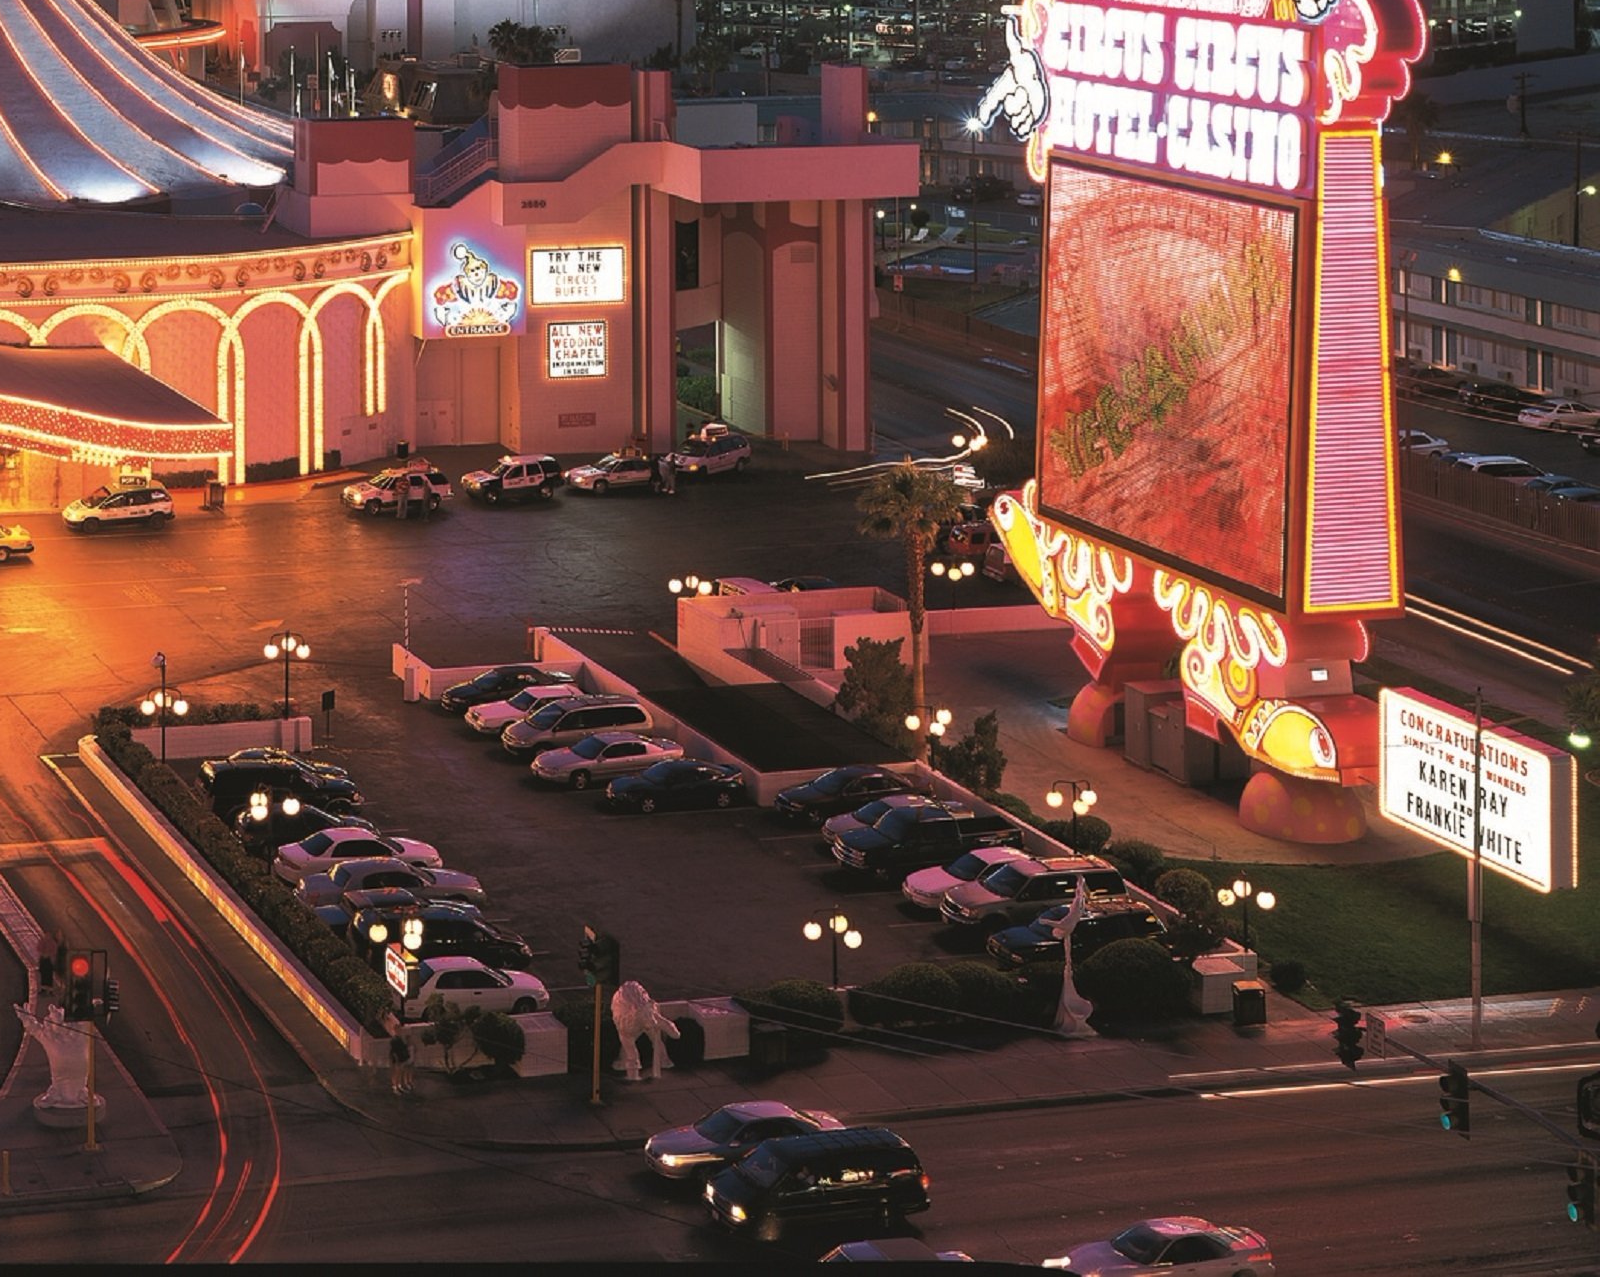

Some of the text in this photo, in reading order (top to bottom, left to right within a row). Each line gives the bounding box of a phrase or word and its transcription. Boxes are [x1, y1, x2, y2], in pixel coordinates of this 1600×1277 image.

[1044, 0, 1306, 107] CIRCUS CIRCUS
[1048, 75, 1304, 191] HOTEL CASINO
[549, 251, 602, 262] TRY THE
[549, 263, 601, 274] ALL NEW
[556, 275, 596, 285] CIRCUS
[555, 285, 597, 296] BUFFET
[449, 325, 504, 336] ENTRANCE
[552, 324, 603, 337] ALL NEW
[553, 336, 603, 348] WEDDING
[556, 348, 600, 360] CHAPEL
[553, 359, 604, 368] INFORMATION
[563, 367, 589, 375] INSIDE
[1401, 709, 1528, 777] CONGRATULATIONS
[1404, 734, 1526, 796] SIMPLY THE BES WINNERS
[1419, 759, 1508, 818] KAREN RAY
[1407, 791, 1467, 839] FRANKIE
[1453, 801, 1473, 818] AND
